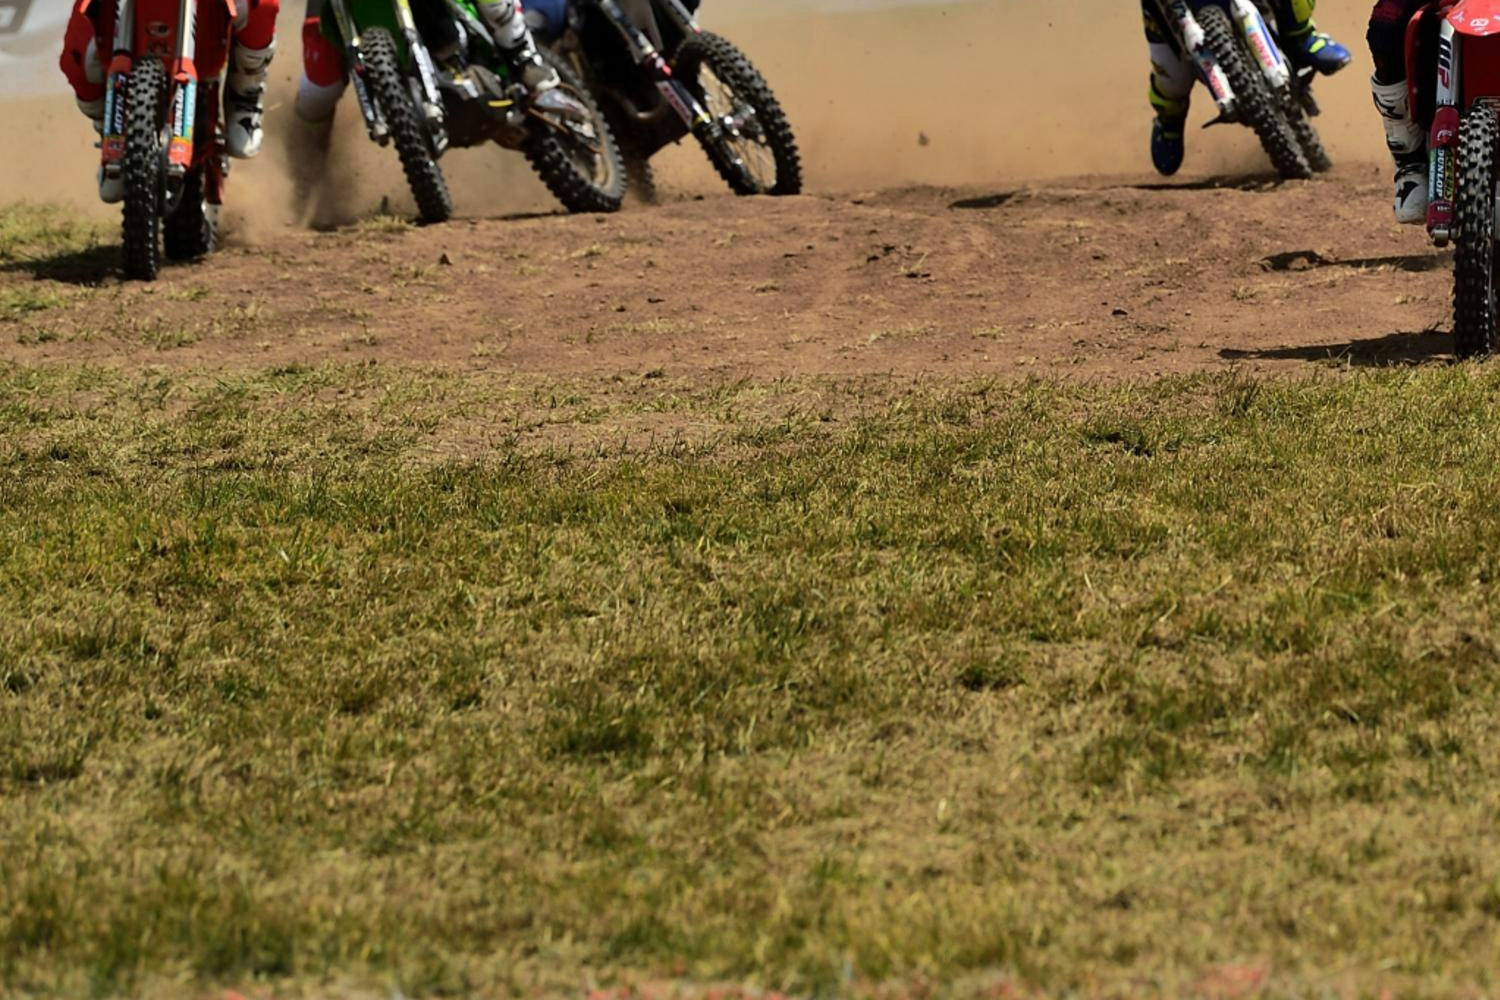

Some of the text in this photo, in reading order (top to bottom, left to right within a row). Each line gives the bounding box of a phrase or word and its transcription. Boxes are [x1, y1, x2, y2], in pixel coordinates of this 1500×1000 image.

[115, 73, 127, 135] DNLOP
[174, 84, 184, 136] DUNLOP
[1436, 148, 1445, 198] DUNLOP
